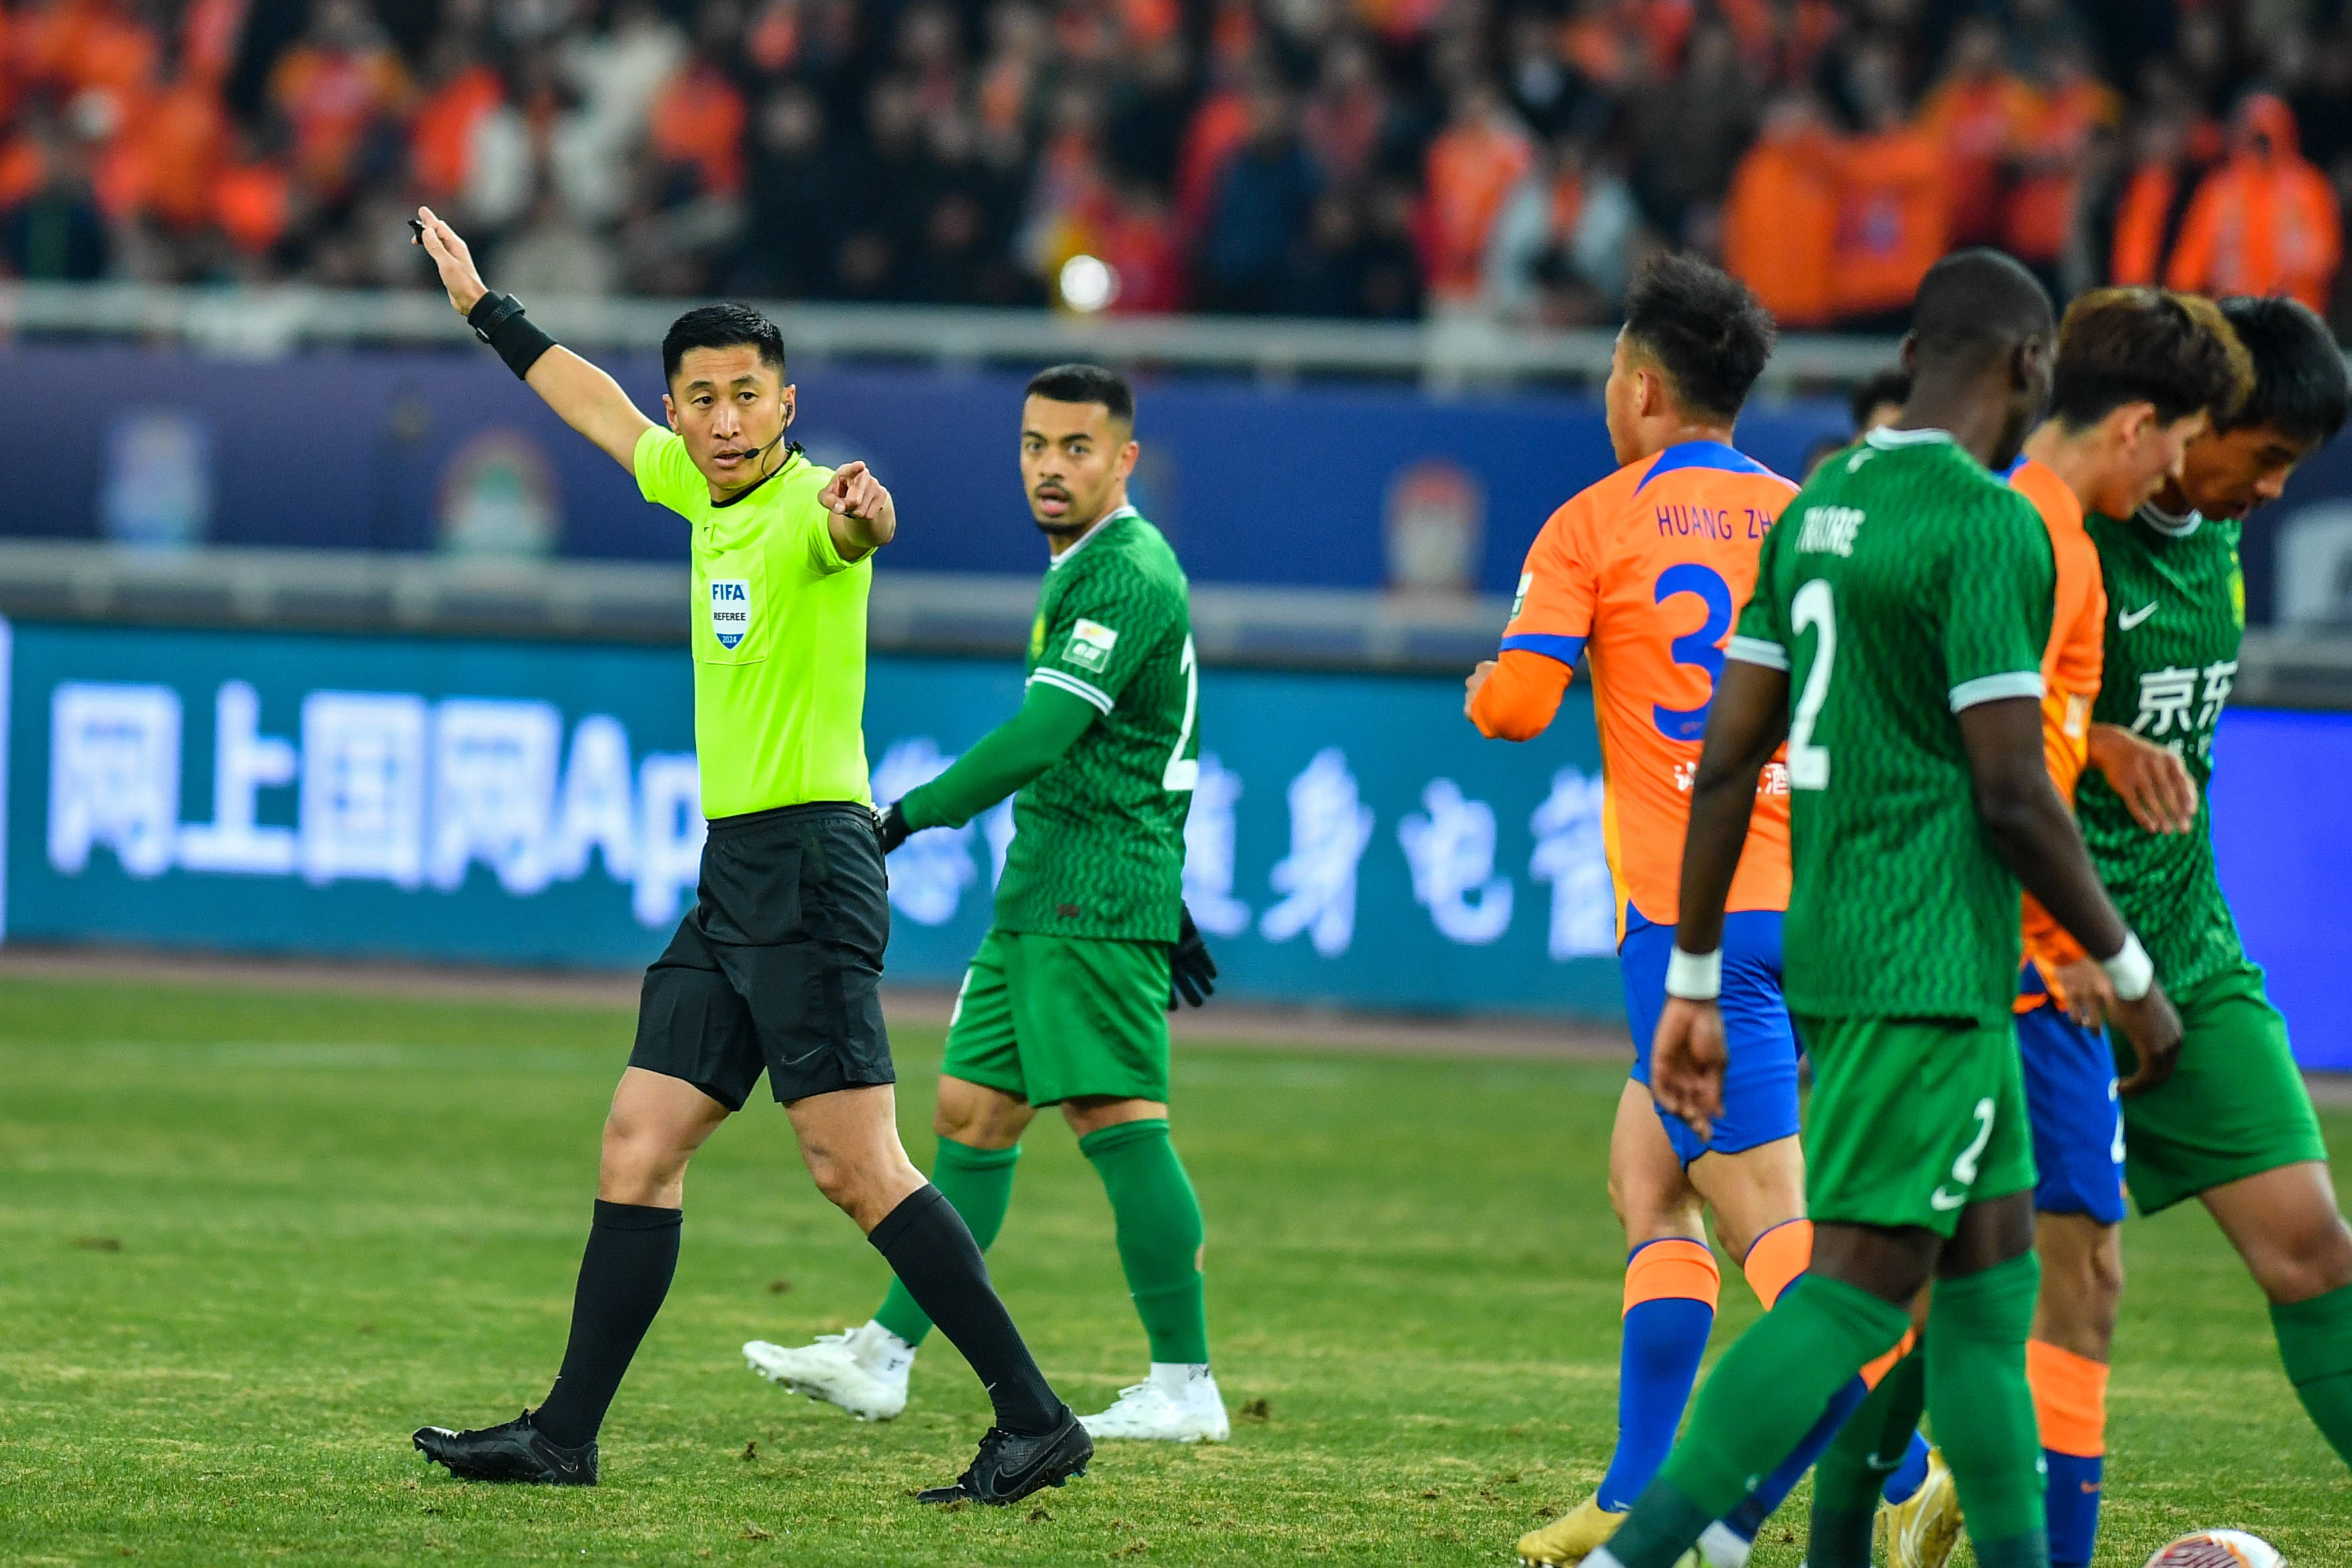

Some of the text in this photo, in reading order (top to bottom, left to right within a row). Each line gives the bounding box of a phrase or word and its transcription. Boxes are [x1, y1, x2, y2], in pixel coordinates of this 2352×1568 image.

[1656, 505, 1733, 540] HUANG
[712, 584, 745, 600] FIFA
[713, 612, 747, 621] REFEREE
[722, 636, 737, 644] 2024
[1652, 562, 1733, 742] 3
[1790, 578, 1837, 791] 2
[1951, 1096, 1996, 1186] 2
